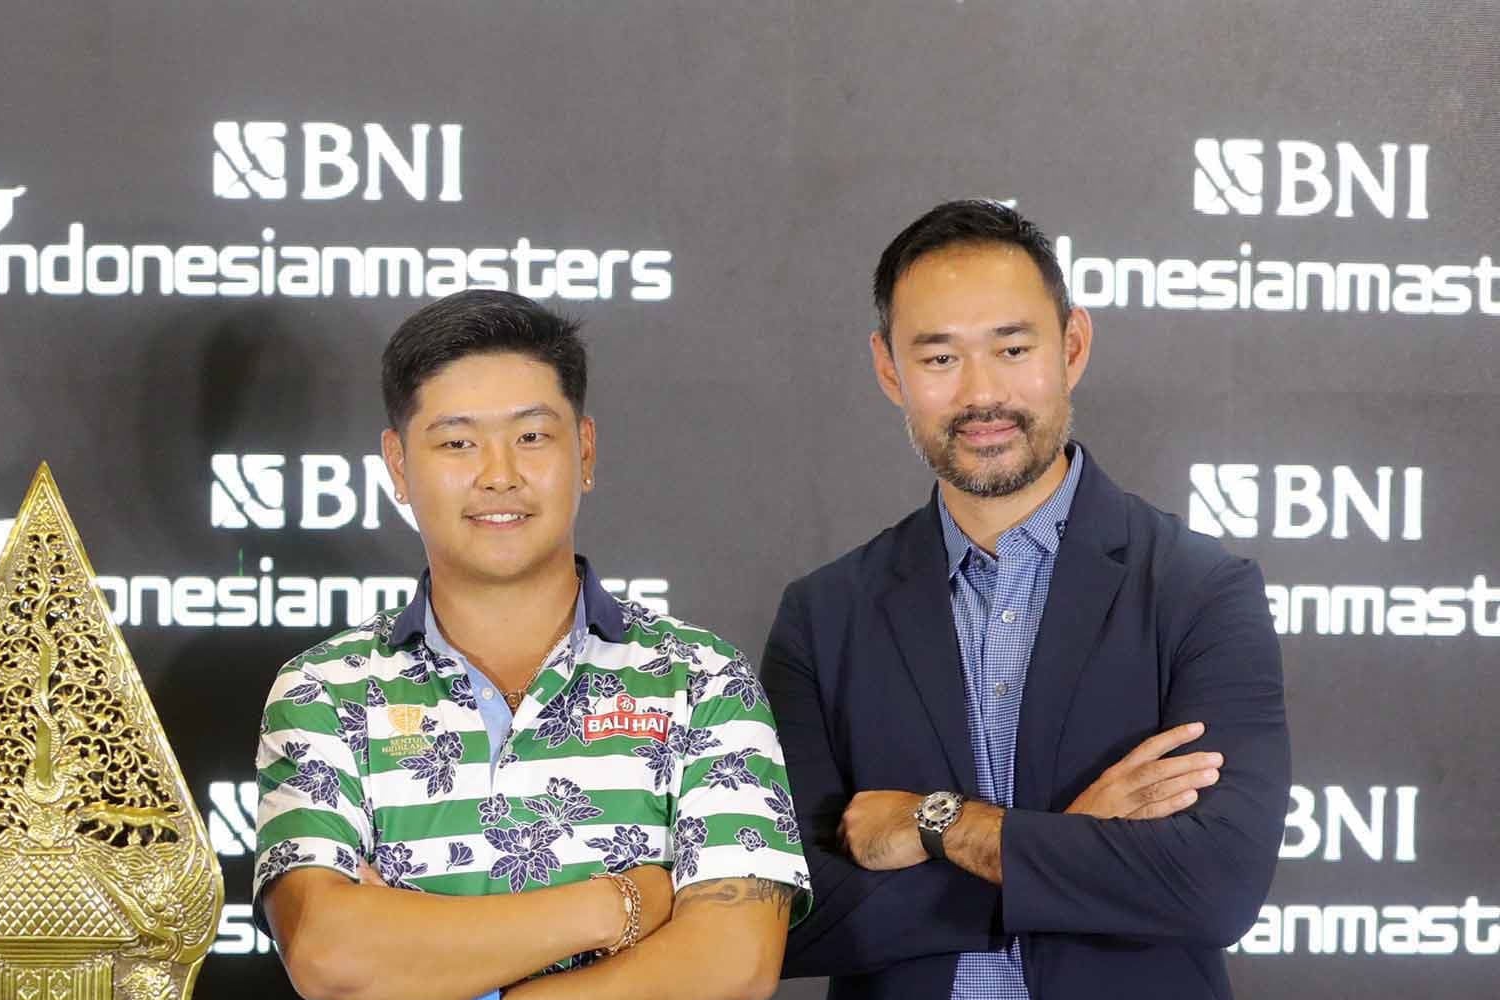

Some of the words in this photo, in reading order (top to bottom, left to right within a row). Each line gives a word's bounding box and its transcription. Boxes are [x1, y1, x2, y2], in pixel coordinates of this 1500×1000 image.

[302, 123, 462, 201] BNI
[1276, 140, 1429, 219] BNI
[1273, 465, 1422, 541] BNI
[587, 715, 629, 733] BALI
[632, 717, 665, 734] HAI
[1276, 782, 1422, 864] BNI
